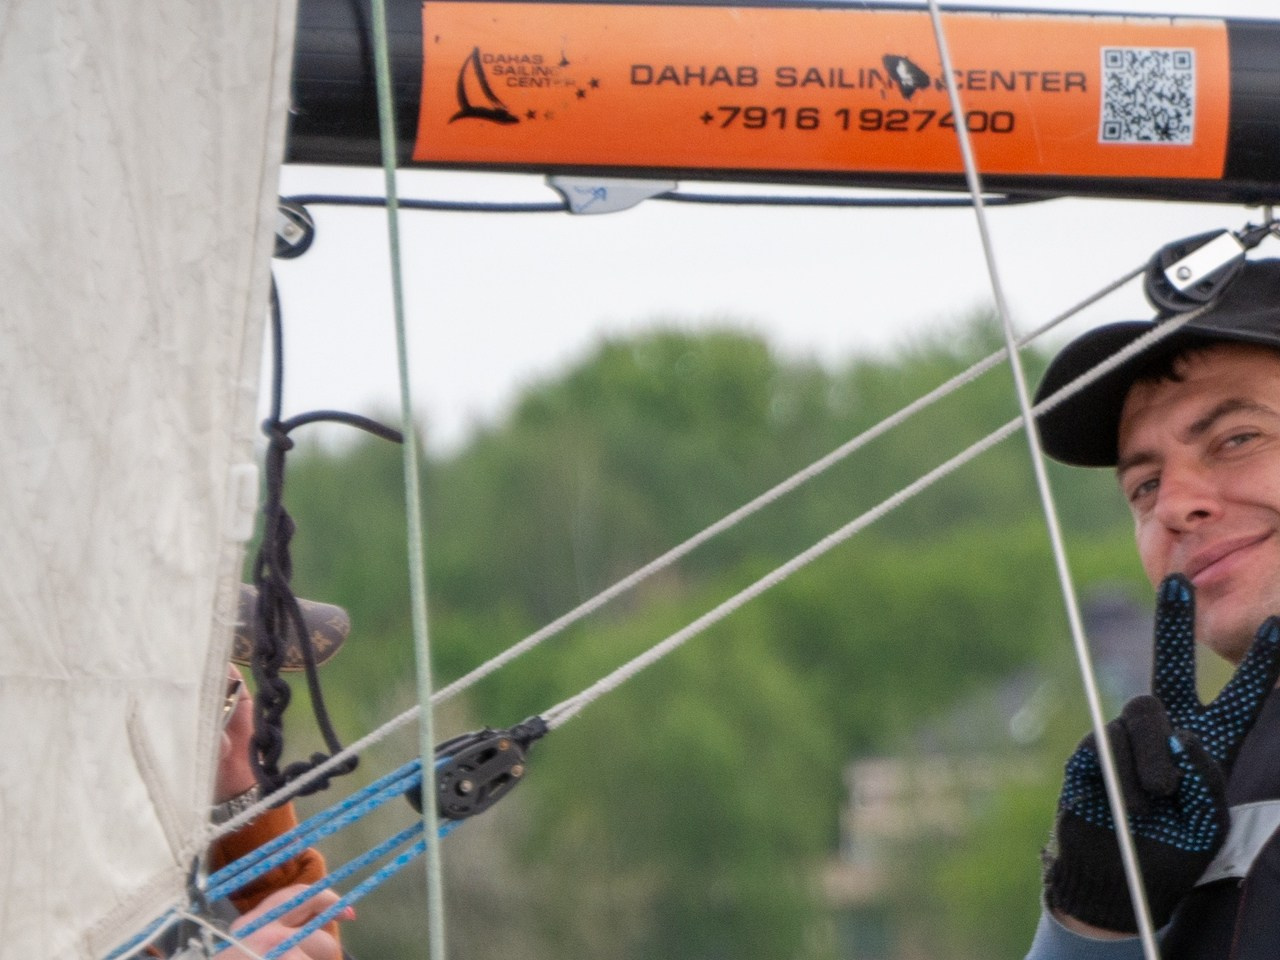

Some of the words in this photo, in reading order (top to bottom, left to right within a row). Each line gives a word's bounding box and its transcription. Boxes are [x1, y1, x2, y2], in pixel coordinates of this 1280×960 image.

[494, 65, 560, 76] SAILIN
[630, 65, 758, 87] DAHAB
[775, 67, 921, 91] SAILIN
[700, 106, 820, 130] +7916
